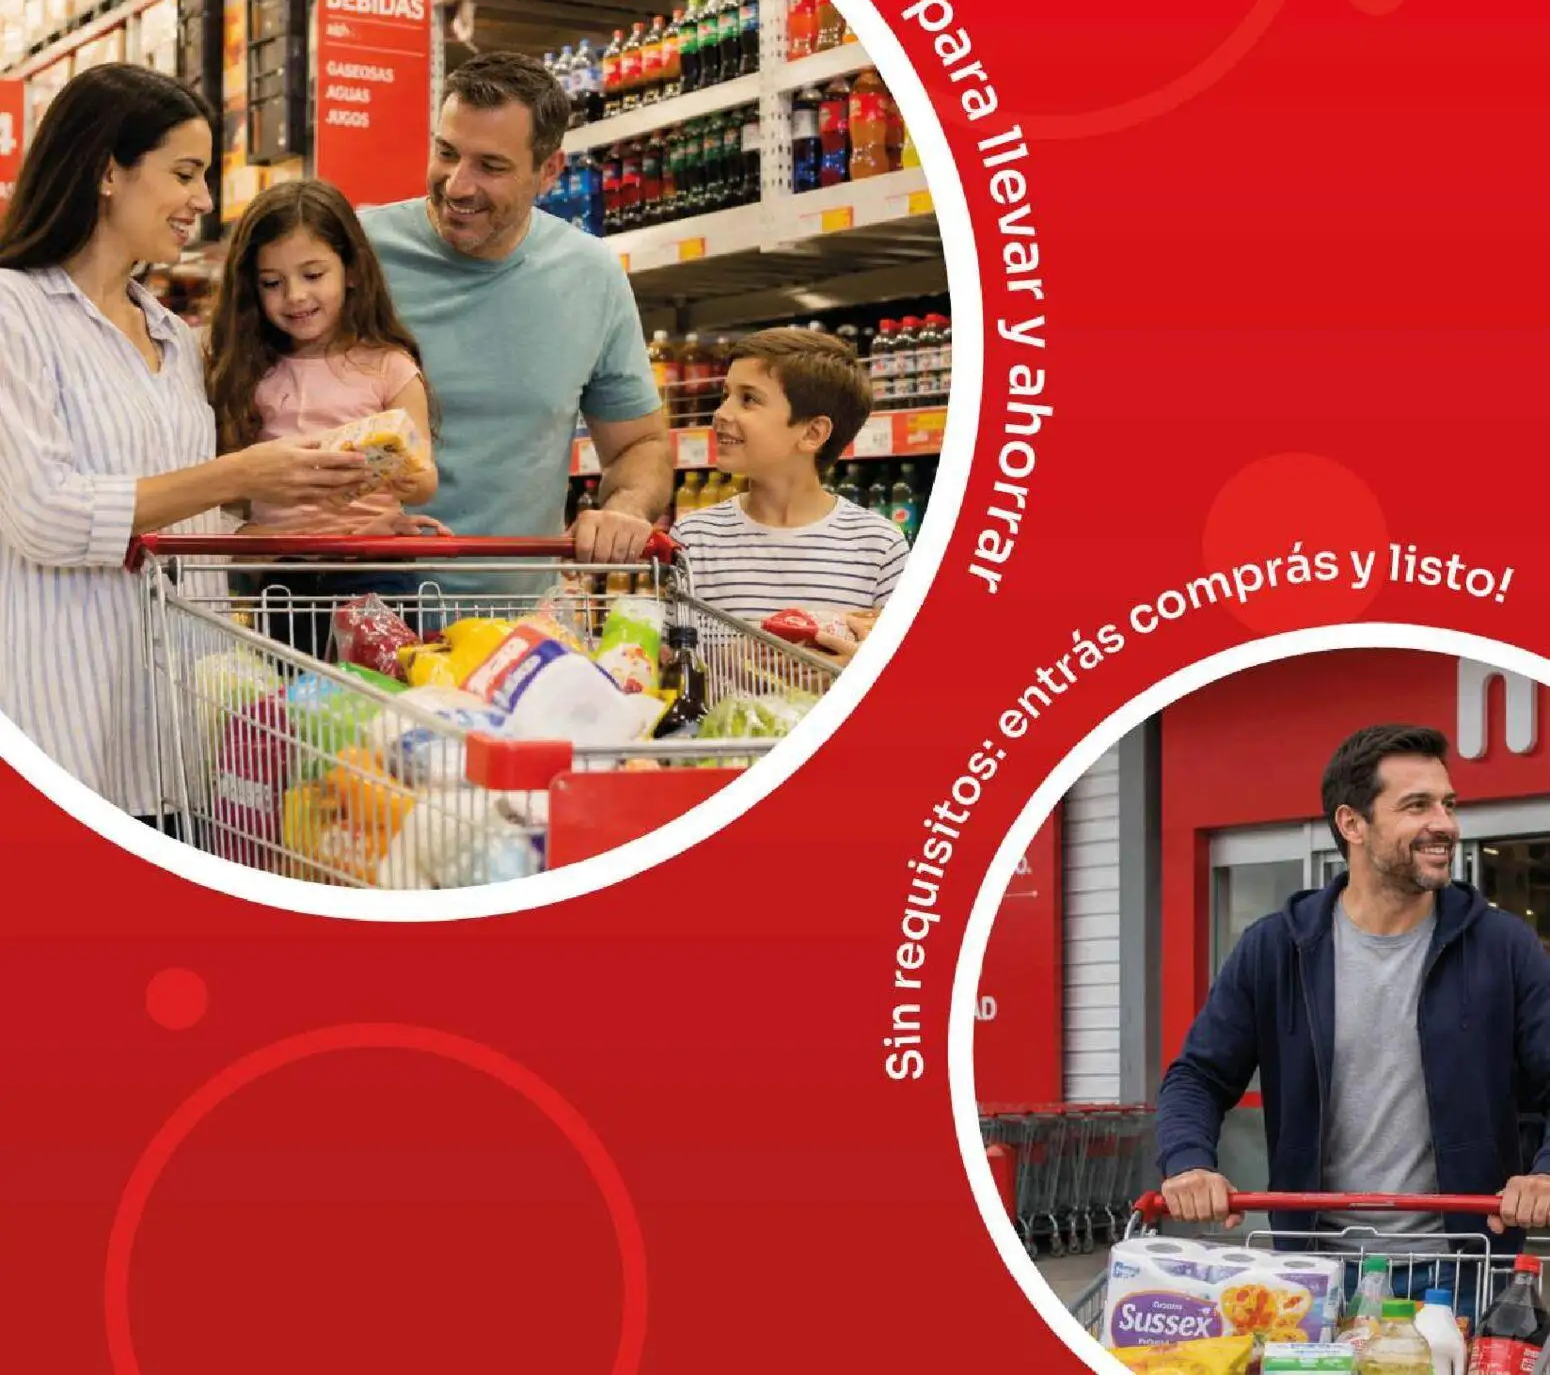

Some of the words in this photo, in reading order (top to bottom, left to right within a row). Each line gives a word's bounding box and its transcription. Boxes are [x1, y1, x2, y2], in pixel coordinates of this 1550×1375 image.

[325, 58, 395, 83] GASEOSAS
[325, 84, 371, 104] AGUAS
[325, 108, 370, 129] JUGOS
[977, 124, 1045, 300] llevar
[997, 316, 1046, 348] y
[969, 364, 1054, 594] ahorrar
[1129, 541, 1339, 634] comprás
[1350, 550, 1376, 590] y
[1389, 543, 1515, 604] listo!
[998, 624, 1125, 738] entrás
[890, 738, 1009, 989] requisitos:
[884, 1004, 924, 1080] Sin
[1119, 1303, 1213, 1339] Sussex
